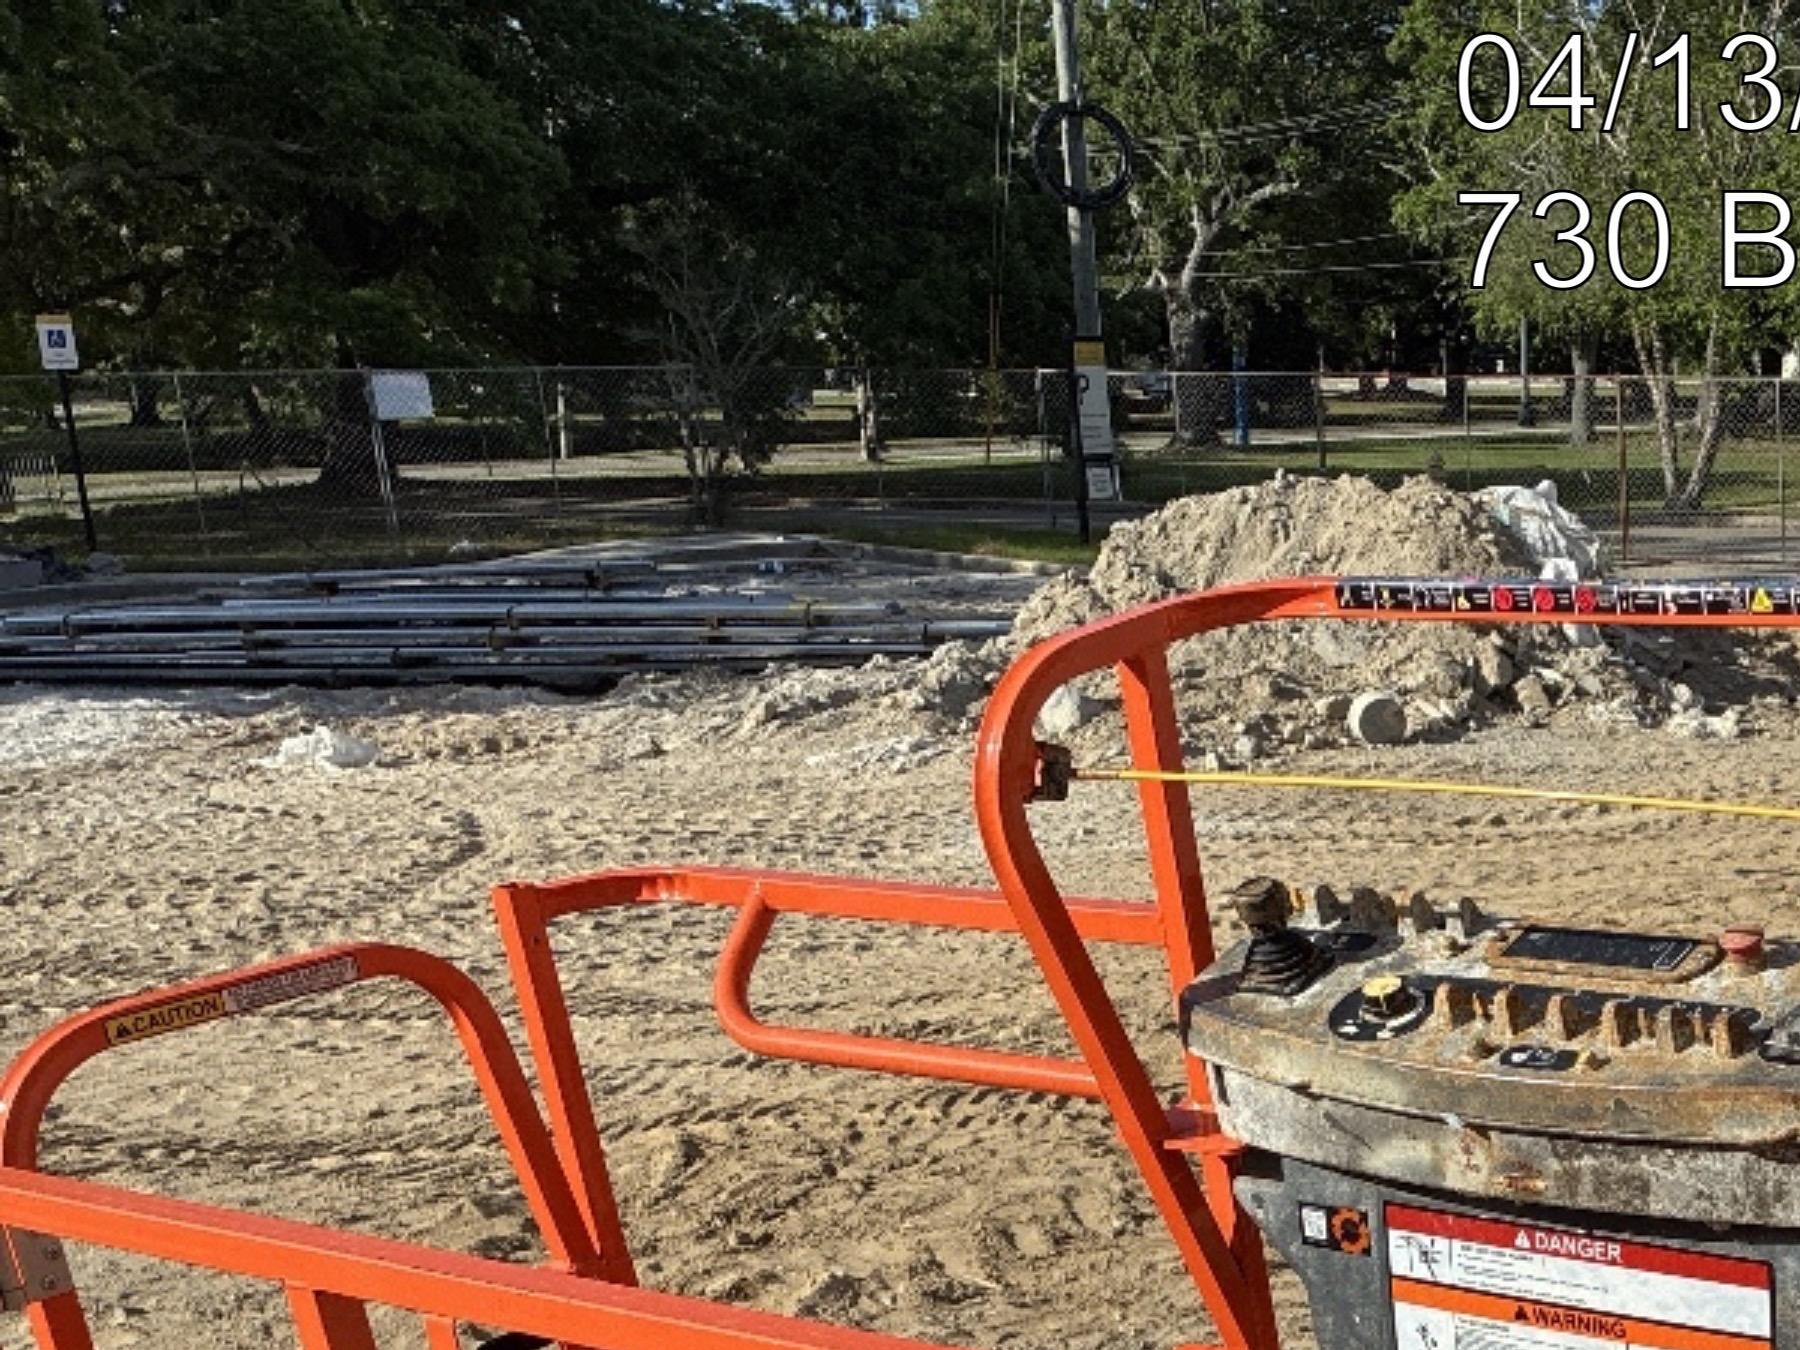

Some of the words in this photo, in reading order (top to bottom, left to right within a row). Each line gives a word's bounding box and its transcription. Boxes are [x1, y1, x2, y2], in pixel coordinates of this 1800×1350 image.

[133, 998, 218, 1032] CAUTION
[1535, 1232, 1623, 1263] DANGER
[1532, 1307, 1628, 1339] WARNING
